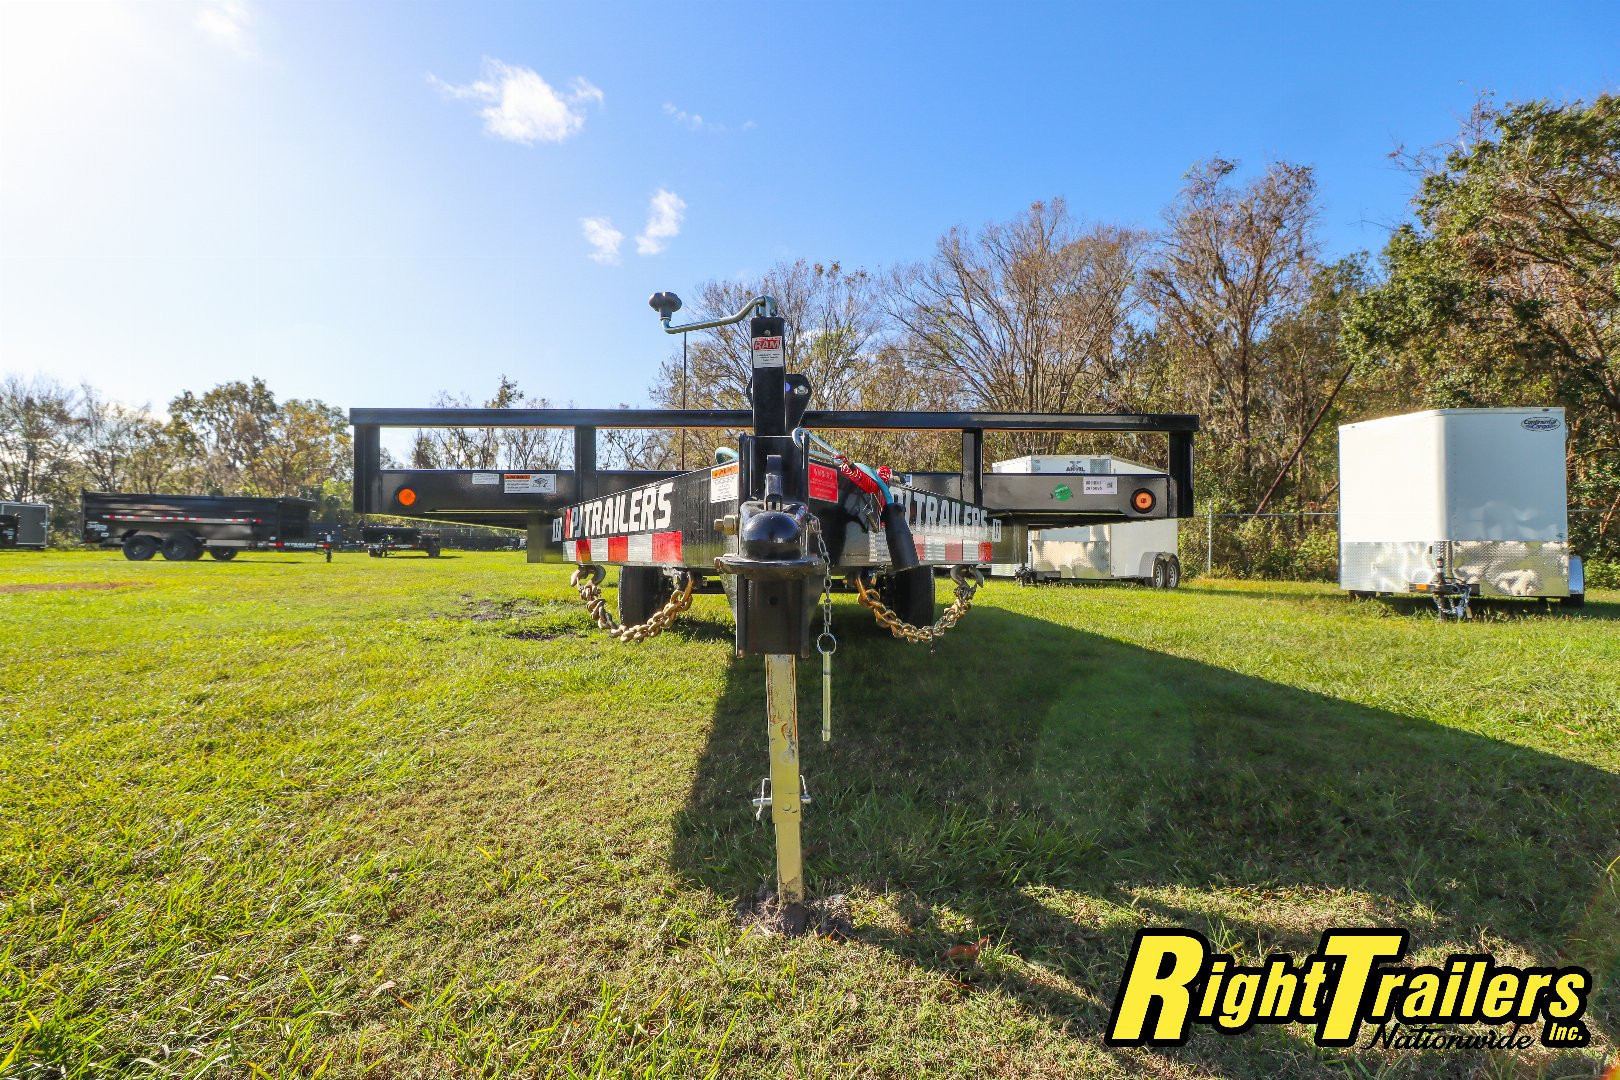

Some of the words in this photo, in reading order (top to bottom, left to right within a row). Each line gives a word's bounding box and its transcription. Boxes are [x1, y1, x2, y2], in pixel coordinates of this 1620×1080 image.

[754, 340, 780, 350] RAM
[584, 481, 674, 537] TRAILERS
[913, 491, 988, 540] TRAILERS
